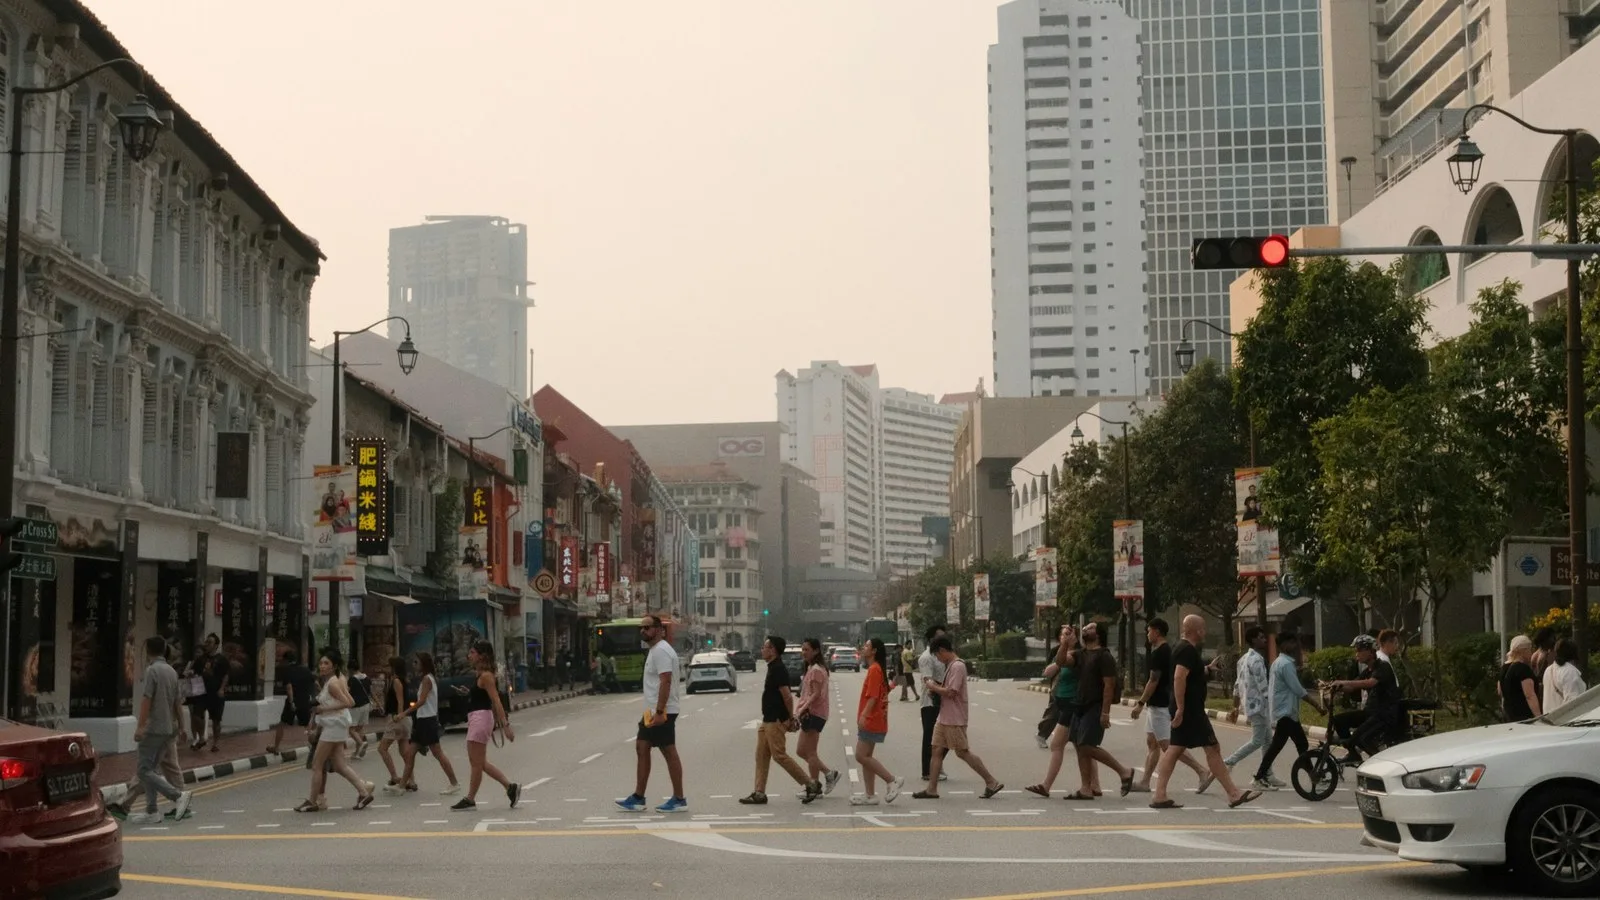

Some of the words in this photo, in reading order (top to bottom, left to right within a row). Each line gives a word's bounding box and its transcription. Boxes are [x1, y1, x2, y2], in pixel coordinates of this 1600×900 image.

[720, 440, 763, 454] OG
[28, 520, 47, 538] Cross
[48, 524, 56, 540] St
